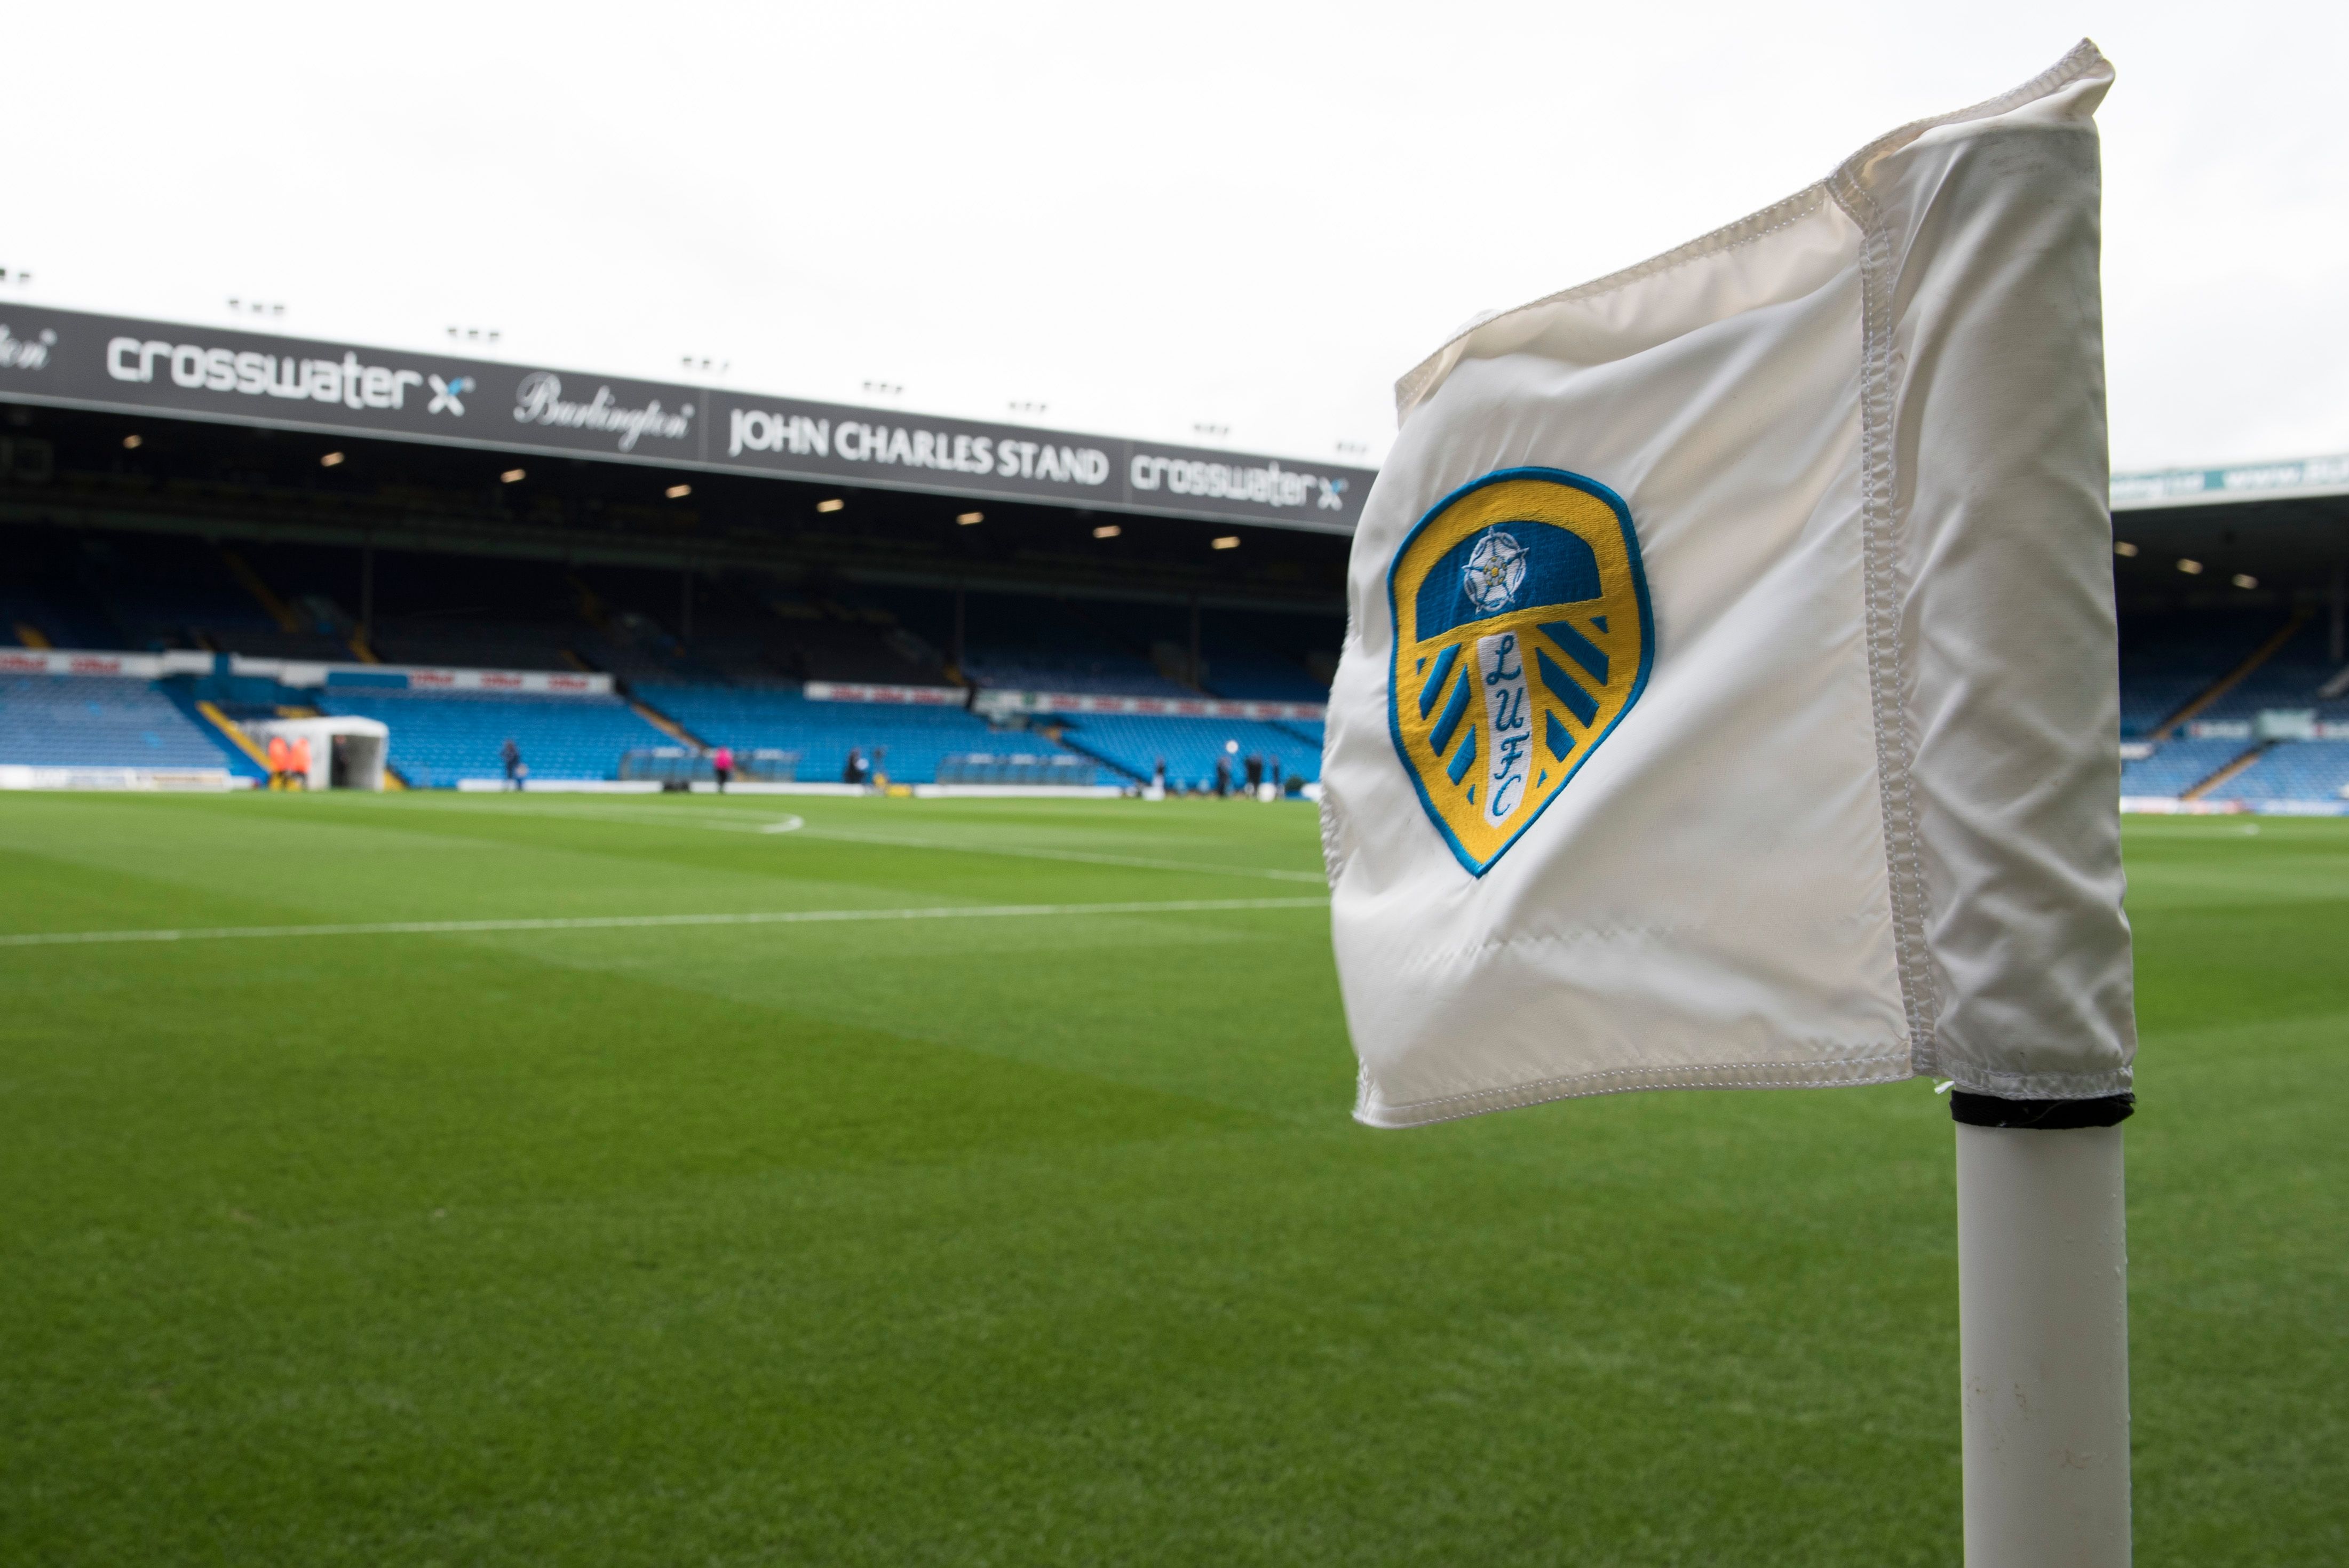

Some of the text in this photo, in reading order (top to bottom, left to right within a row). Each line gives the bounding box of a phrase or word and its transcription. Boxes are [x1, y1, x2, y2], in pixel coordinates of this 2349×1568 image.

[107, 337, 423, 410] crosswater
[513, 372, 689, 453] Burlington
[728, 408, 1110, 485] JOHN CHARLES STAND
[1130, 455, 1318, 507] crosswater
